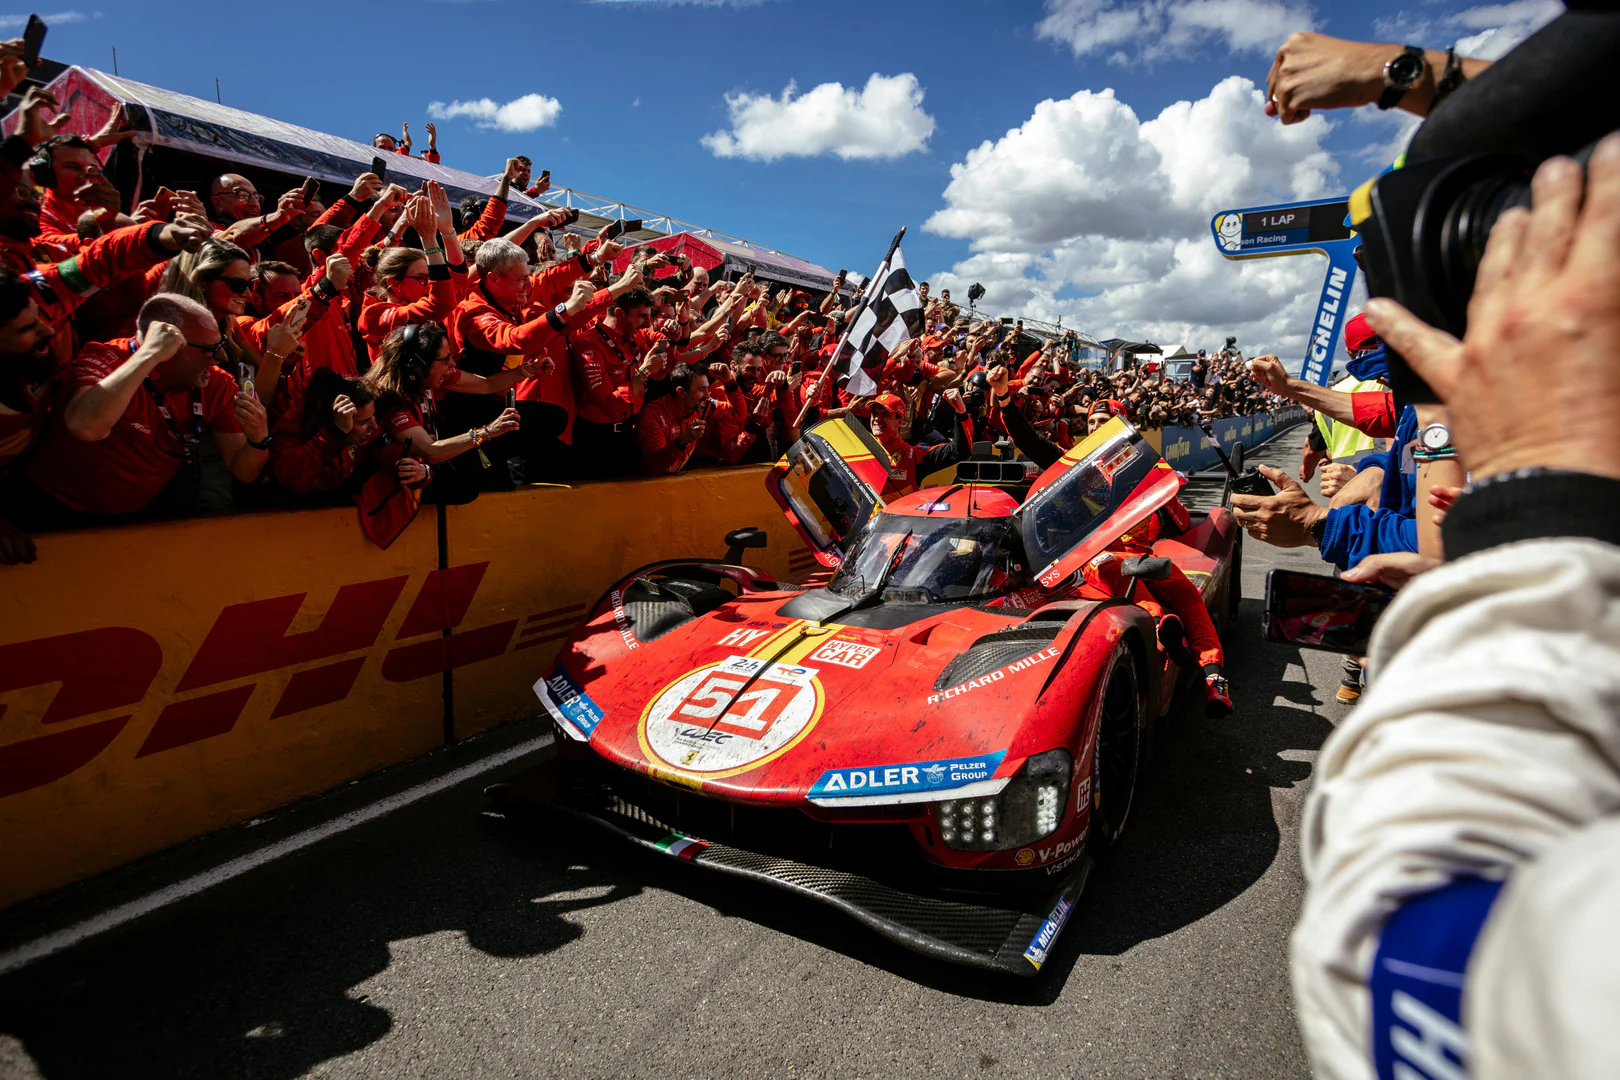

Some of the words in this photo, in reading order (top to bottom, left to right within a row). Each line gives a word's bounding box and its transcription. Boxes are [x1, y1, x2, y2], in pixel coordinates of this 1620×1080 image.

[1261, 218, 1267, 227] 1
[1271, 214, 1295, 226] LAP
[1257, 234, 1287, 244] Racing
[1041, 569, 1060, 587] SYS
[611, 589, 625, 624] RICHARD
[618, 623, 640, 651] MILLE
[815, 648, 869, 668] CAR
[829, 641, 875, 655] HYPER
[0, 561, 519, 797] DHL
[927, 671, 1004, 705] RICHARD
[1008, 646, 1060, 674] MILLE
[546, 674, 582, 709] ADLER
[679, 677, 782, 731] 51
[950, 762, 987, 771] PELZER
[951, 771, 988, 781] GROUP
[823, 766, 919, 792] ADLER
[1038, 900, 1068, 948] MICHELIN
